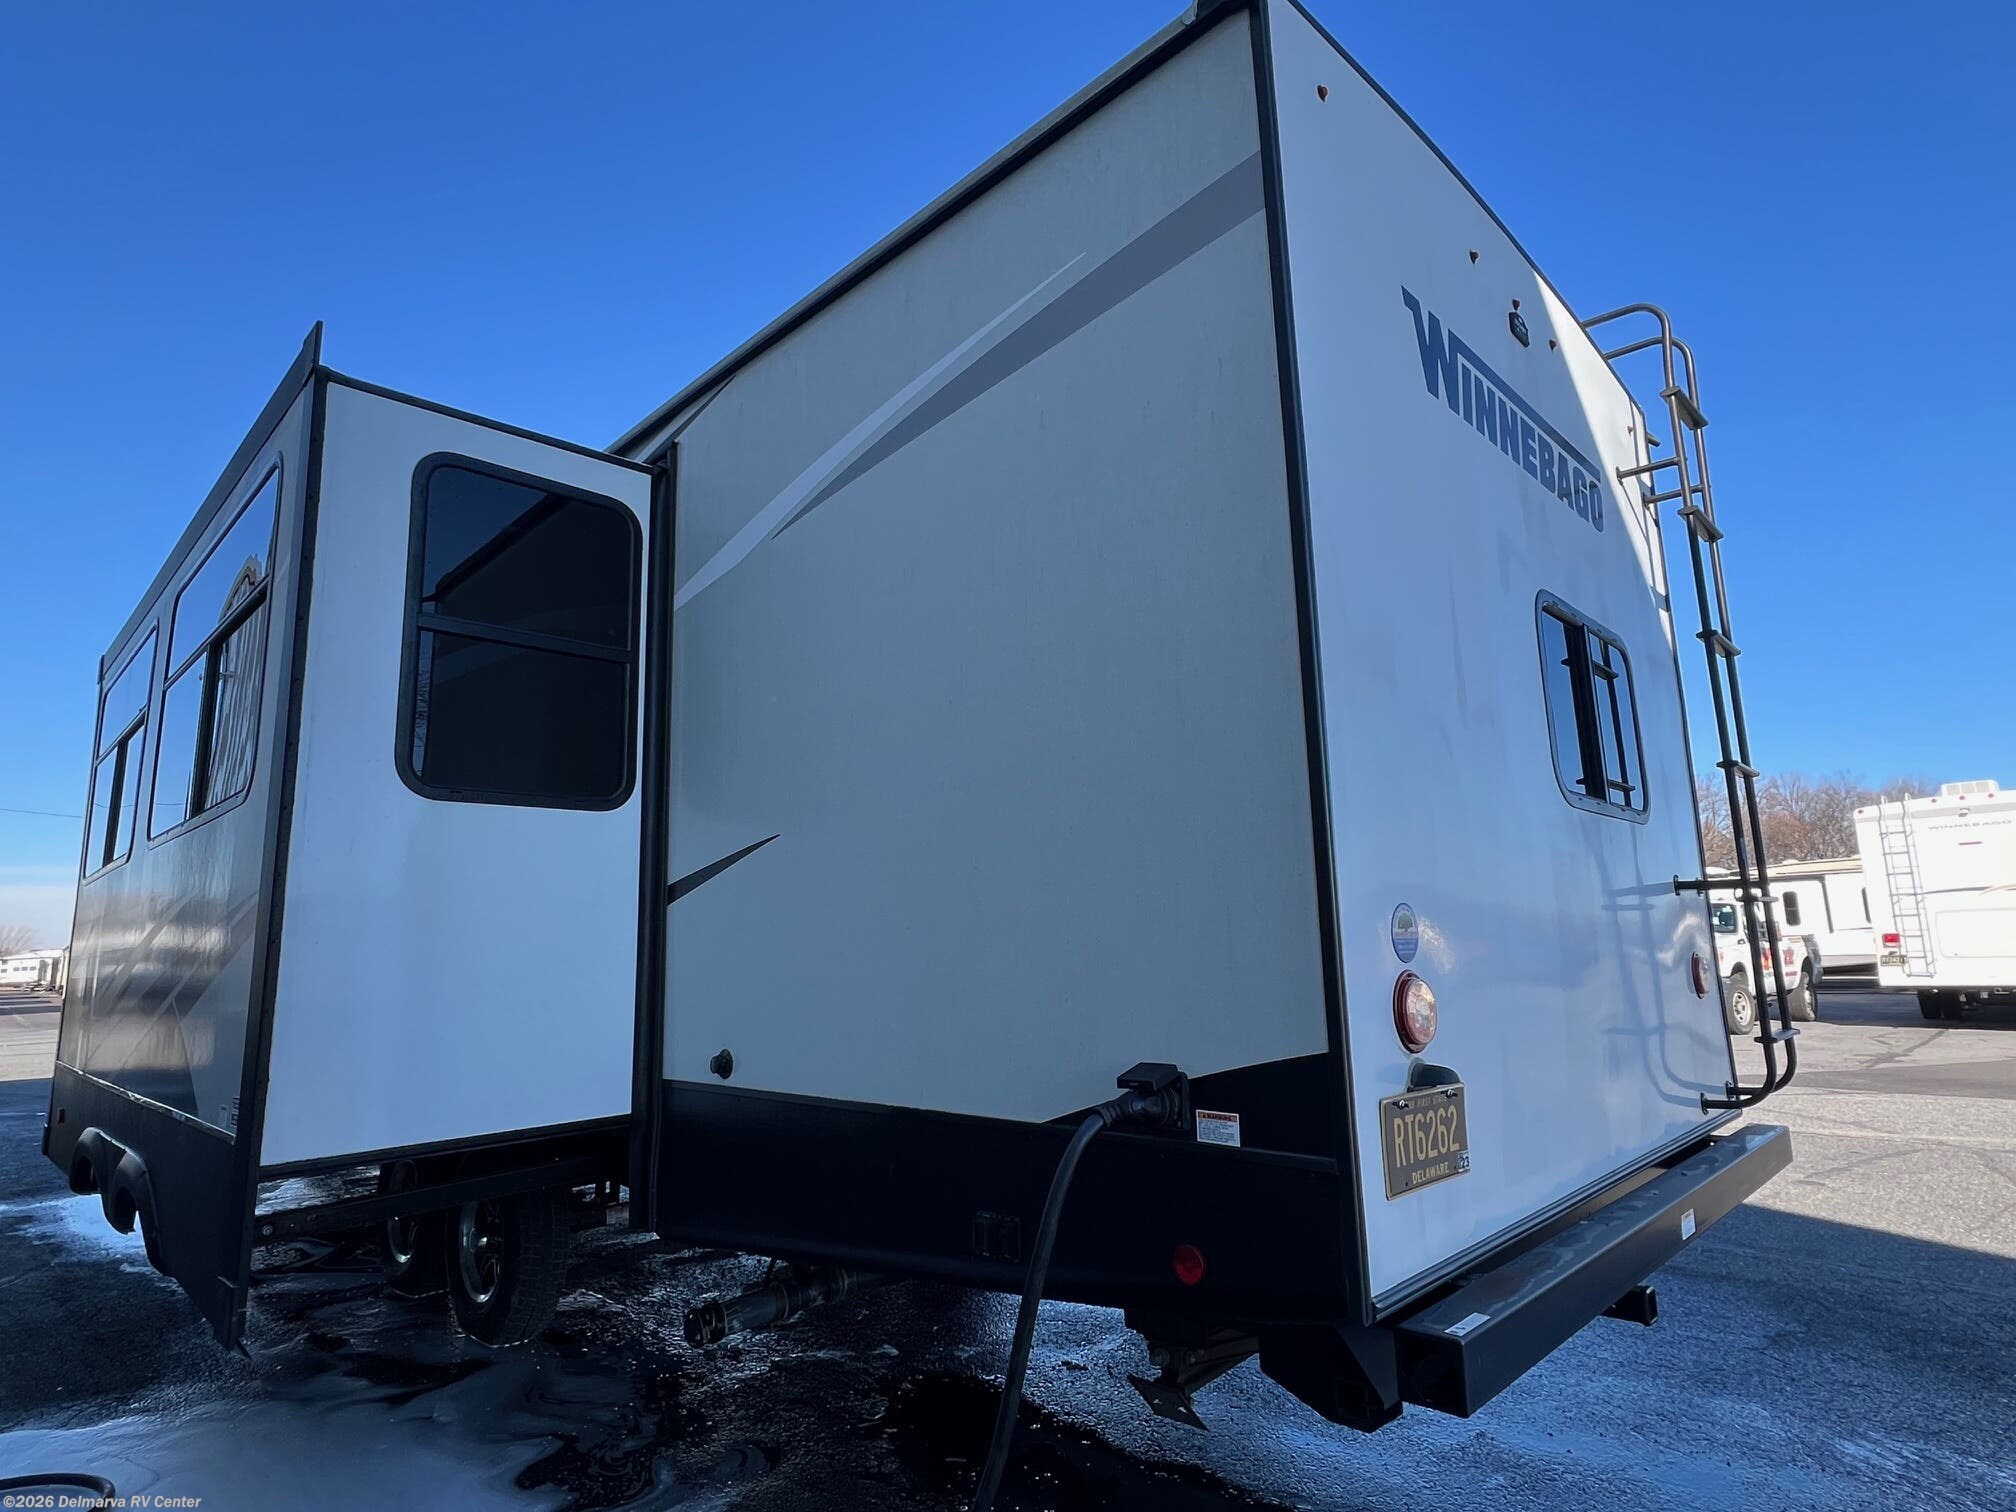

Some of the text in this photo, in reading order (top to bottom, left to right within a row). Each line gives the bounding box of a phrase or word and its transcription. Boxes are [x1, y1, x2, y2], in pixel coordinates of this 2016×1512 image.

[1401, 284, 1604, 533] WINNEBAGO
[1394, 1105, 1459, 1168] RT6262
[1412, 1162, 1449, 1184] DELAWARE
